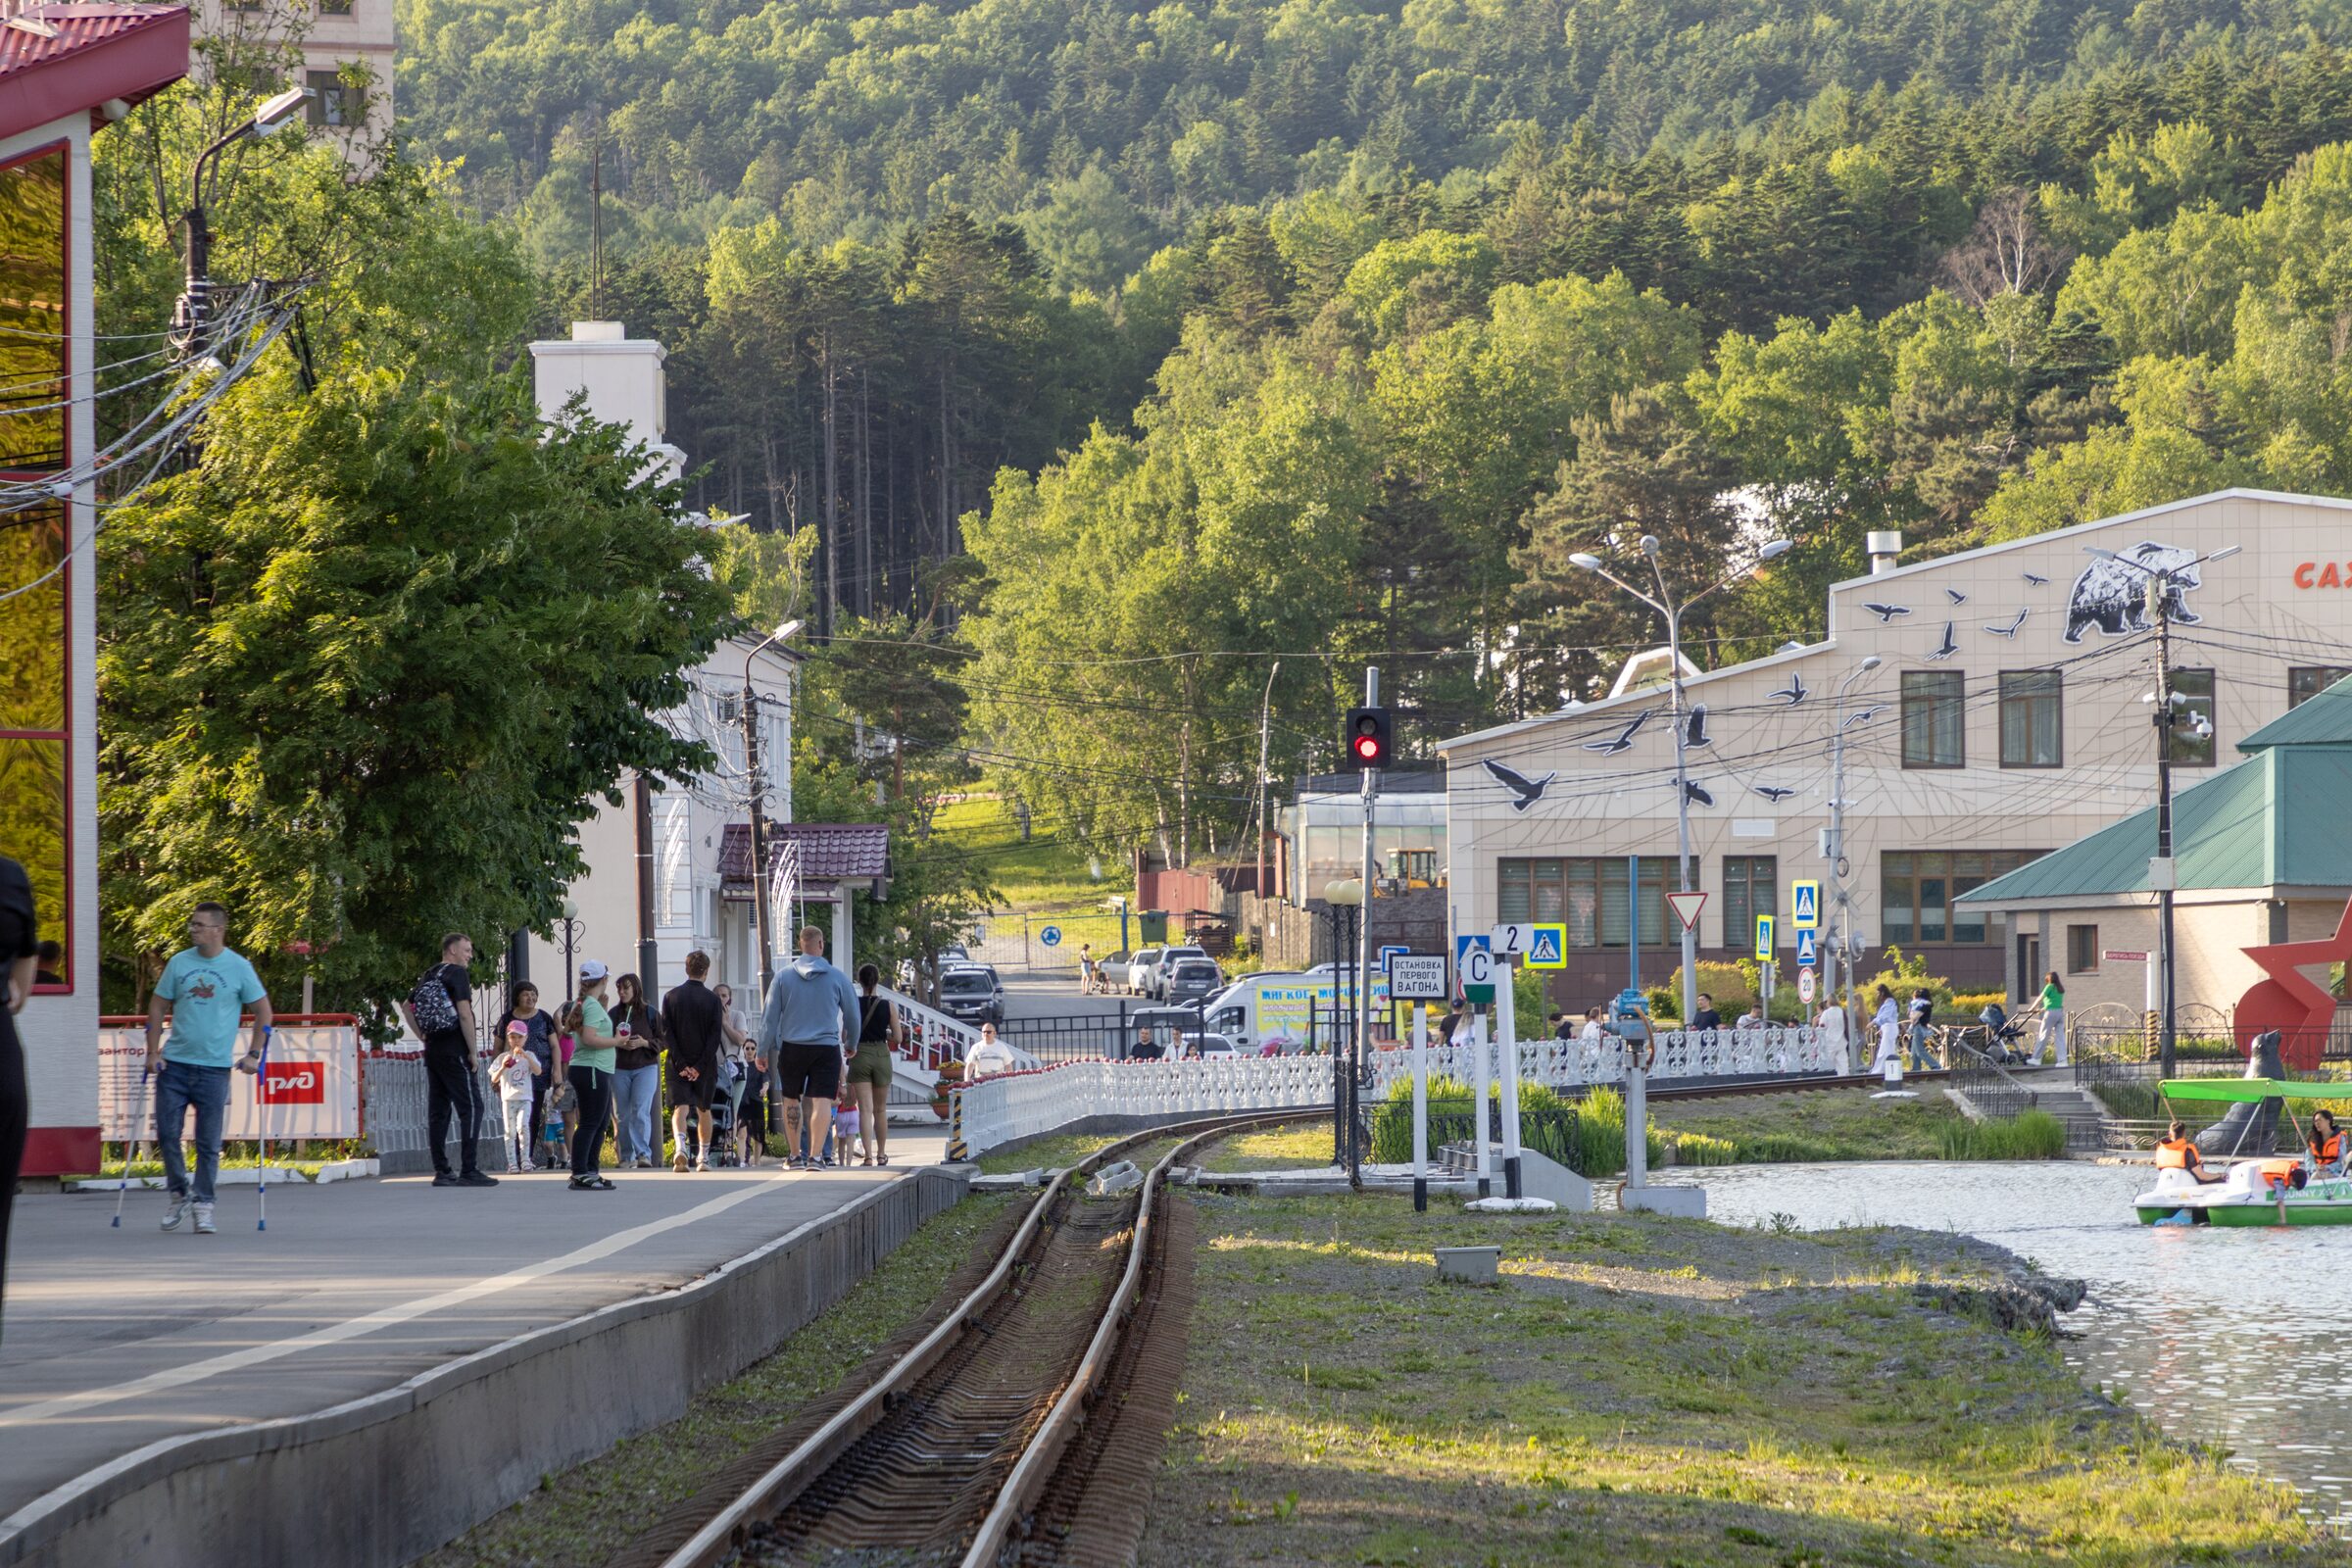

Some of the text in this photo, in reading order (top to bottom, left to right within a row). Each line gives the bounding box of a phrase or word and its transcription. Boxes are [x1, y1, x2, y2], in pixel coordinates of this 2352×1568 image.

[1507, 926, 1518, 952] 2
[1395, 960, 1442, 970] ОСТАНОВКА
[1472, 954, 1488, 981] С
[1400, 971, 1437, 981] ПЕРВОГО
[1397, 981, 1440, 993] ВАГОНА
[1803, 979, 1812, 992] 20
[1262, 988, 1310, 1001] МЯГКОЕ
